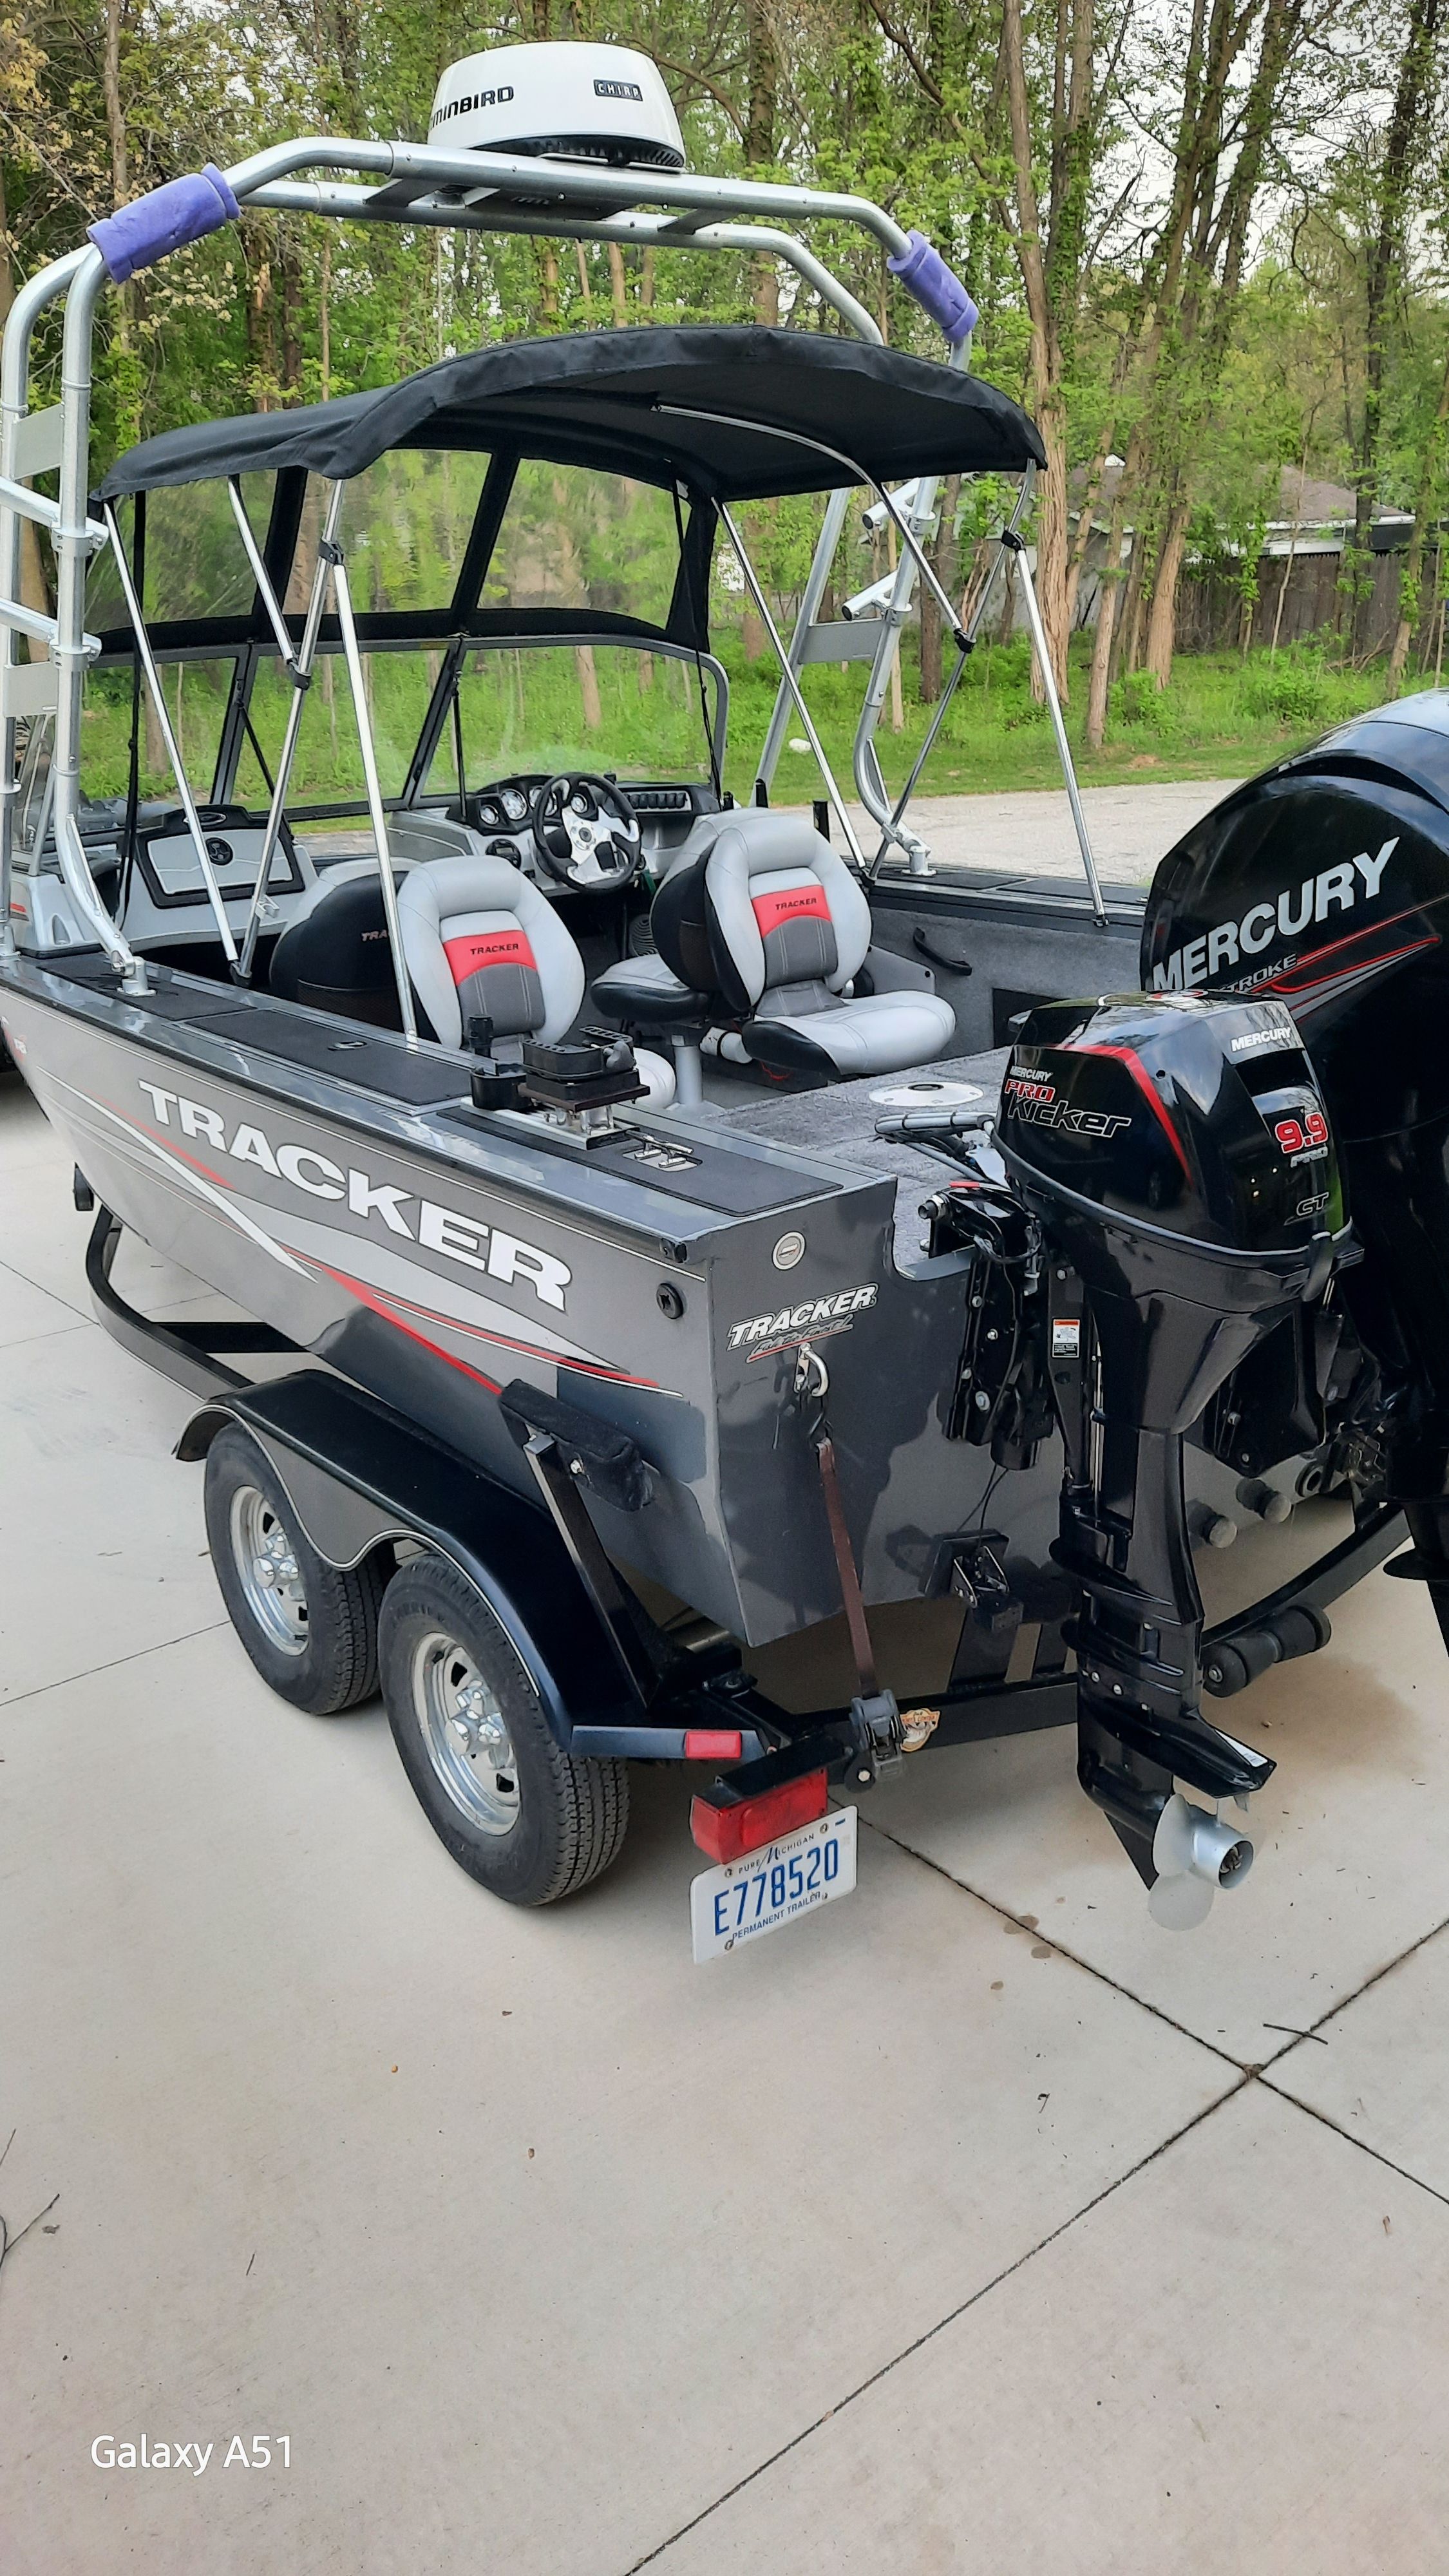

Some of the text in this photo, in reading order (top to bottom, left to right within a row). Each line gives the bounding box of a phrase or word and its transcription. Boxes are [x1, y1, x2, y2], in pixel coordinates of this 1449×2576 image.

[431, 86, 514, 129] MINBIRD
[598, 82, 639, 97] CHIRP
[775, 898, 817, 910] TRACKER
[1153, 837, 1399, 990] MERCURY
[470, 943, 519, 955] TRACKER
[1231, 1027, 1291, 1052] MERCURY
[1005, 1079, 1056, 1103] PRO
[1010, 1066, 1053, 1082] MERCURY
[1274, 1112, 1328, 1153] 9.9
[1290, 1146, 1328, 1168] PRO
[138, 1079, 573, 1312] TRACKER
[728, 1283, 877, 1350] TRACKER
[739, 1833, 815, 1874] PURE MICHIGAN
[714, 1838, 838, 1937] E778520
[732, 1891, 821, 1940] PERMANENT TRAILER
